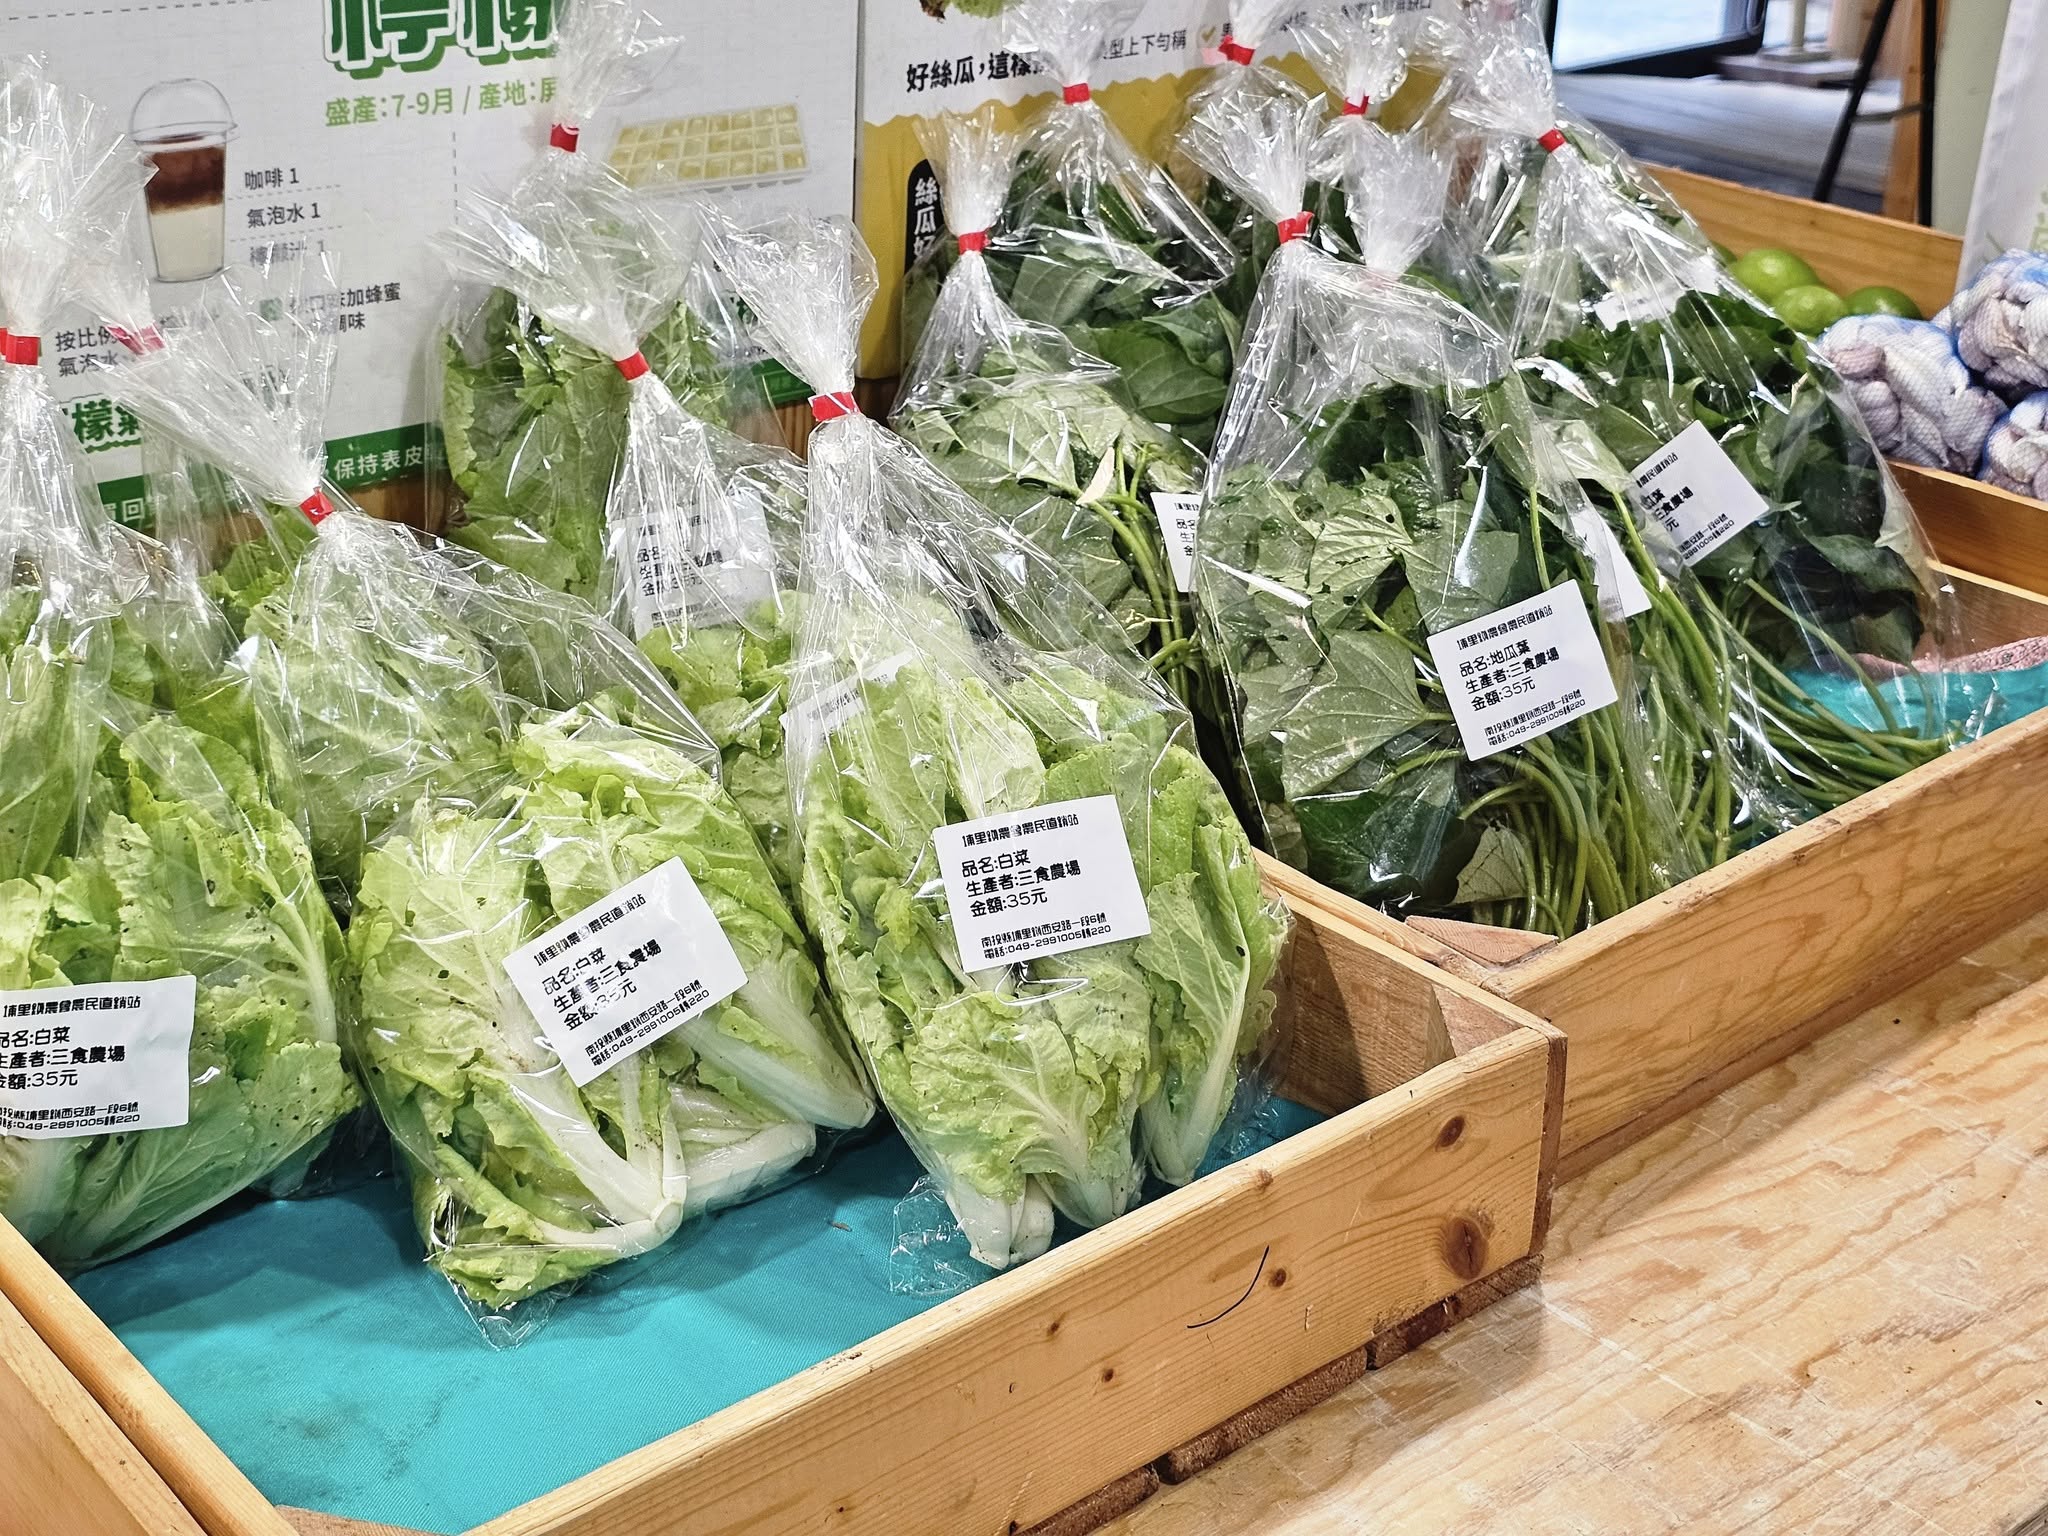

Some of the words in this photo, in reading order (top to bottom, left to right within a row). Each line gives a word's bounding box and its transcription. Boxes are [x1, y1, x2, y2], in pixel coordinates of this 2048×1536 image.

[244, 168, 284, 190] 咖啡
[290, 168, 299, 184] 1
[247, 203, 305, 229] 氣泡水
[311, 203, 321, 218] 1
[334, 445, 424, 481] 保持表皮
[1459, 639, 1531, 678] 品名:地瓜葉
[1465, 647, 1560, 695] 生產者:三食農場
[1471, 676, 1536, 712] 金額:35元
[961, 848, 1031, 878] 品名:白菜
[966, 859, 1081, 898] 生產者:三食農場
[969, 887, 1048, 918] 金額:35元
